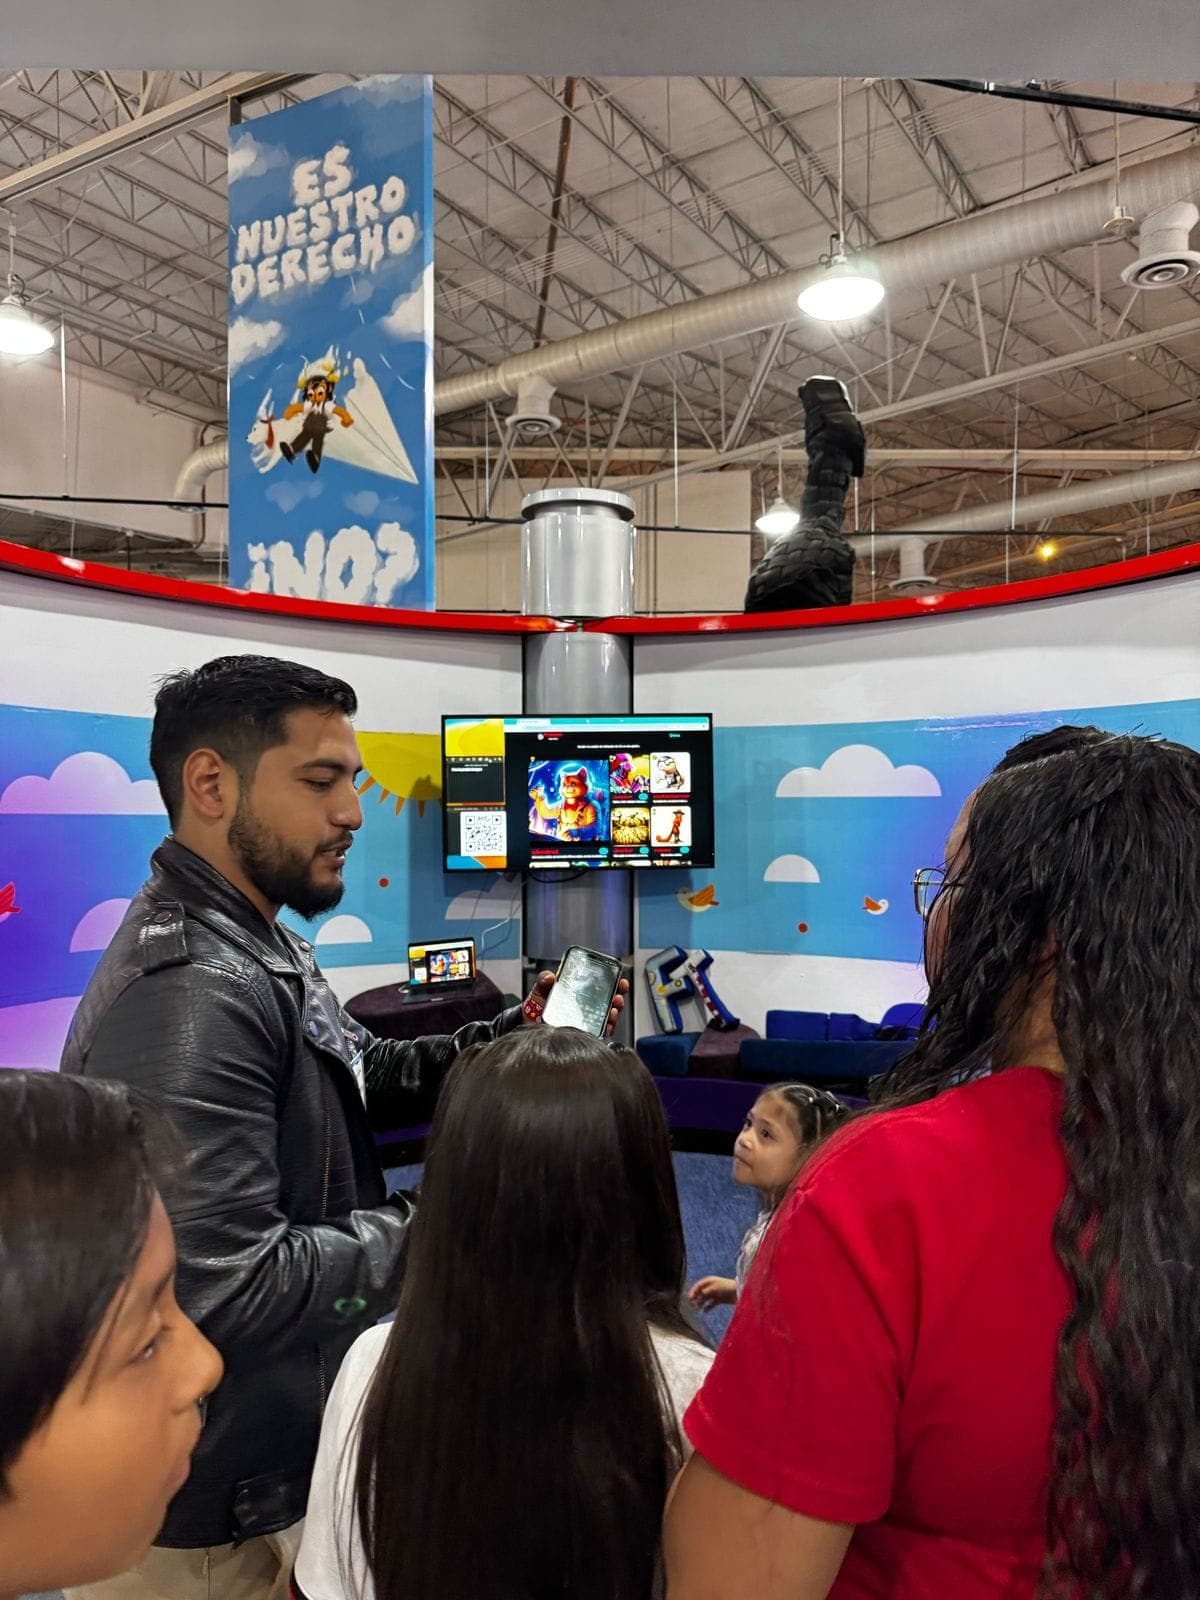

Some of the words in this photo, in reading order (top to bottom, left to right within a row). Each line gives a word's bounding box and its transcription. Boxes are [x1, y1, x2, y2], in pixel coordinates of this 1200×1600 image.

[235, 175, 406, 263] NUESTRO
[292, 145, 352, 206] ES
[231, 215, 415, 305] DERECHO
